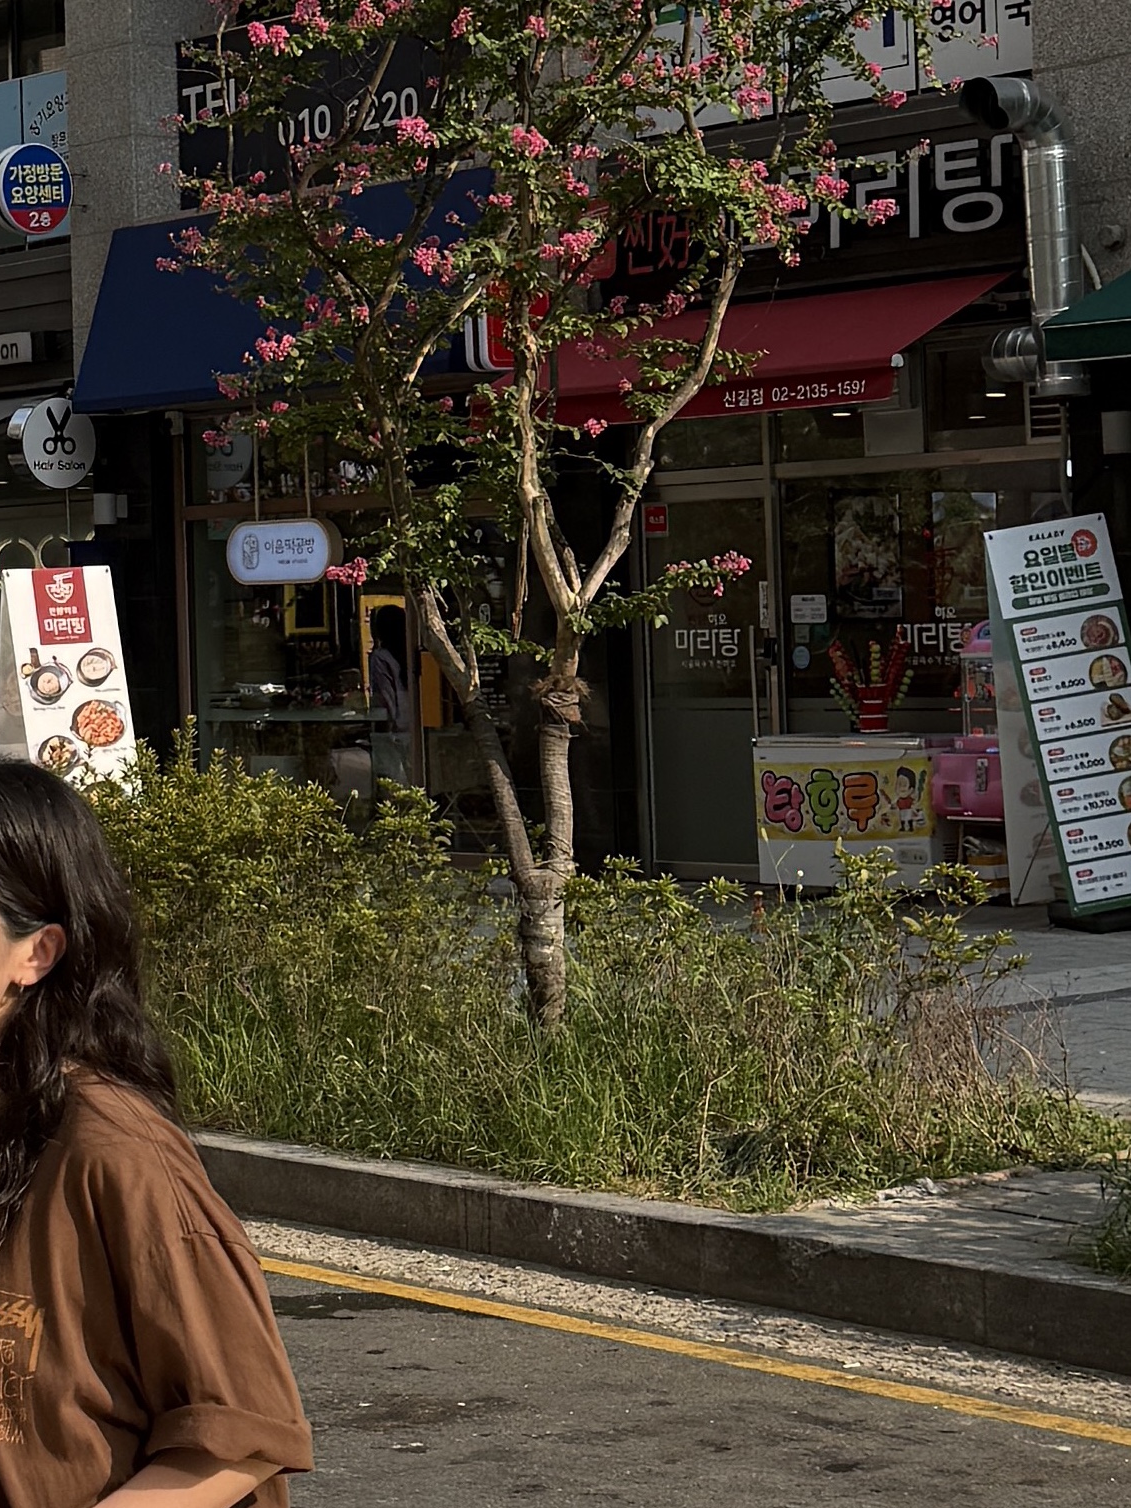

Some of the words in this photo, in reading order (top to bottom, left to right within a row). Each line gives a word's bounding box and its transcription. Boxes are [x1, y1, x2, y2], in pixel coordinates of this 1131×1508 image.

[9, 163, 64, 184] 가정방문
[11, 184, 65, 205] 요양센터
[723, 387, 764, 408] 신길점
[771, 379, 866, 402] 02-2135-1591
[33, 460, 54, 471] Hair
[58, 460, 86, 471] Salon
[1024, 543, 1077, 568] 요일별
[1009, 562, 1103, 594] 할인이벤트
[675, 628, 742, 657] 마라탕
[762, 769, 879, 834] 탕후루
